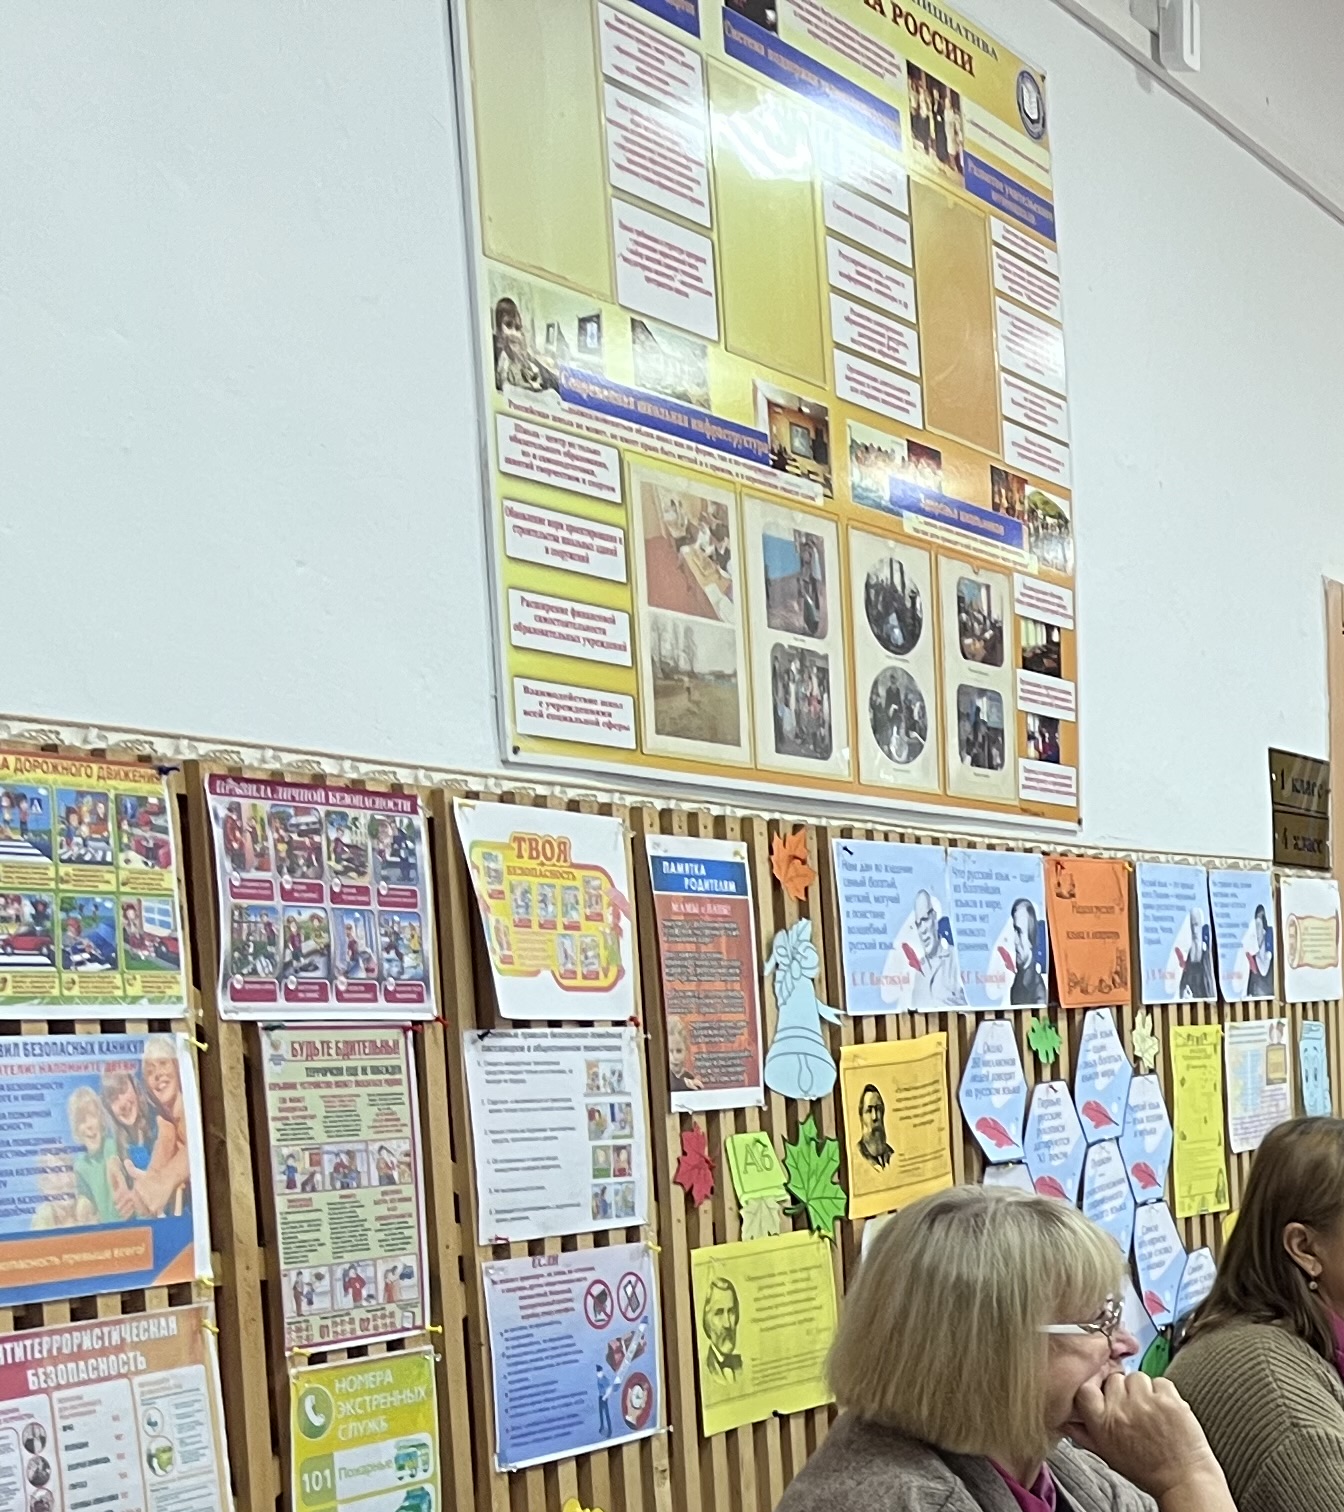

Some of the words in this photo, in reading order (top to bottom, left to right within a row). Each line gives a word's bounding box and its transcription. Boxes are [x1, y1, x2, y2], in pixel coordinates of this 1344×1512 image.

[890, 1, 976, 78] РОССИИ
[13, 755, 94, 778] ДОРОЖНОГО
[216, 779, 273, 799] ПРАВИЛА
[273, 785, 326, 804] ЛИЧНОЙ
[328, 790, 412, 813] БЕЗОПАСНОСТИ
[512, 835, 569, 863] ТВОЯ
[662, 861, 707, 876] ПАМЯТКА
[683, 877, 737, 893] РОДИТЕЛЯМ
[22, 1041, 96, 1057] БЕЗОПАСНЫХ
[98, 1040, 144, 1055] КАНИКУЛ
[290, 1040, 333, 1061] БУДЬТЕ
[26, 1351, 147, 1391] БЕЗОПАСНОСТЬ
[335, 1369, 393, 1395] НОМЕРА
[337, 1385, 427, 1418] ЭКСТРЕННЫХ
[338, 1416, 389, 1441] СЛУЖБ
[302, 1468, 332, 1494] 101
